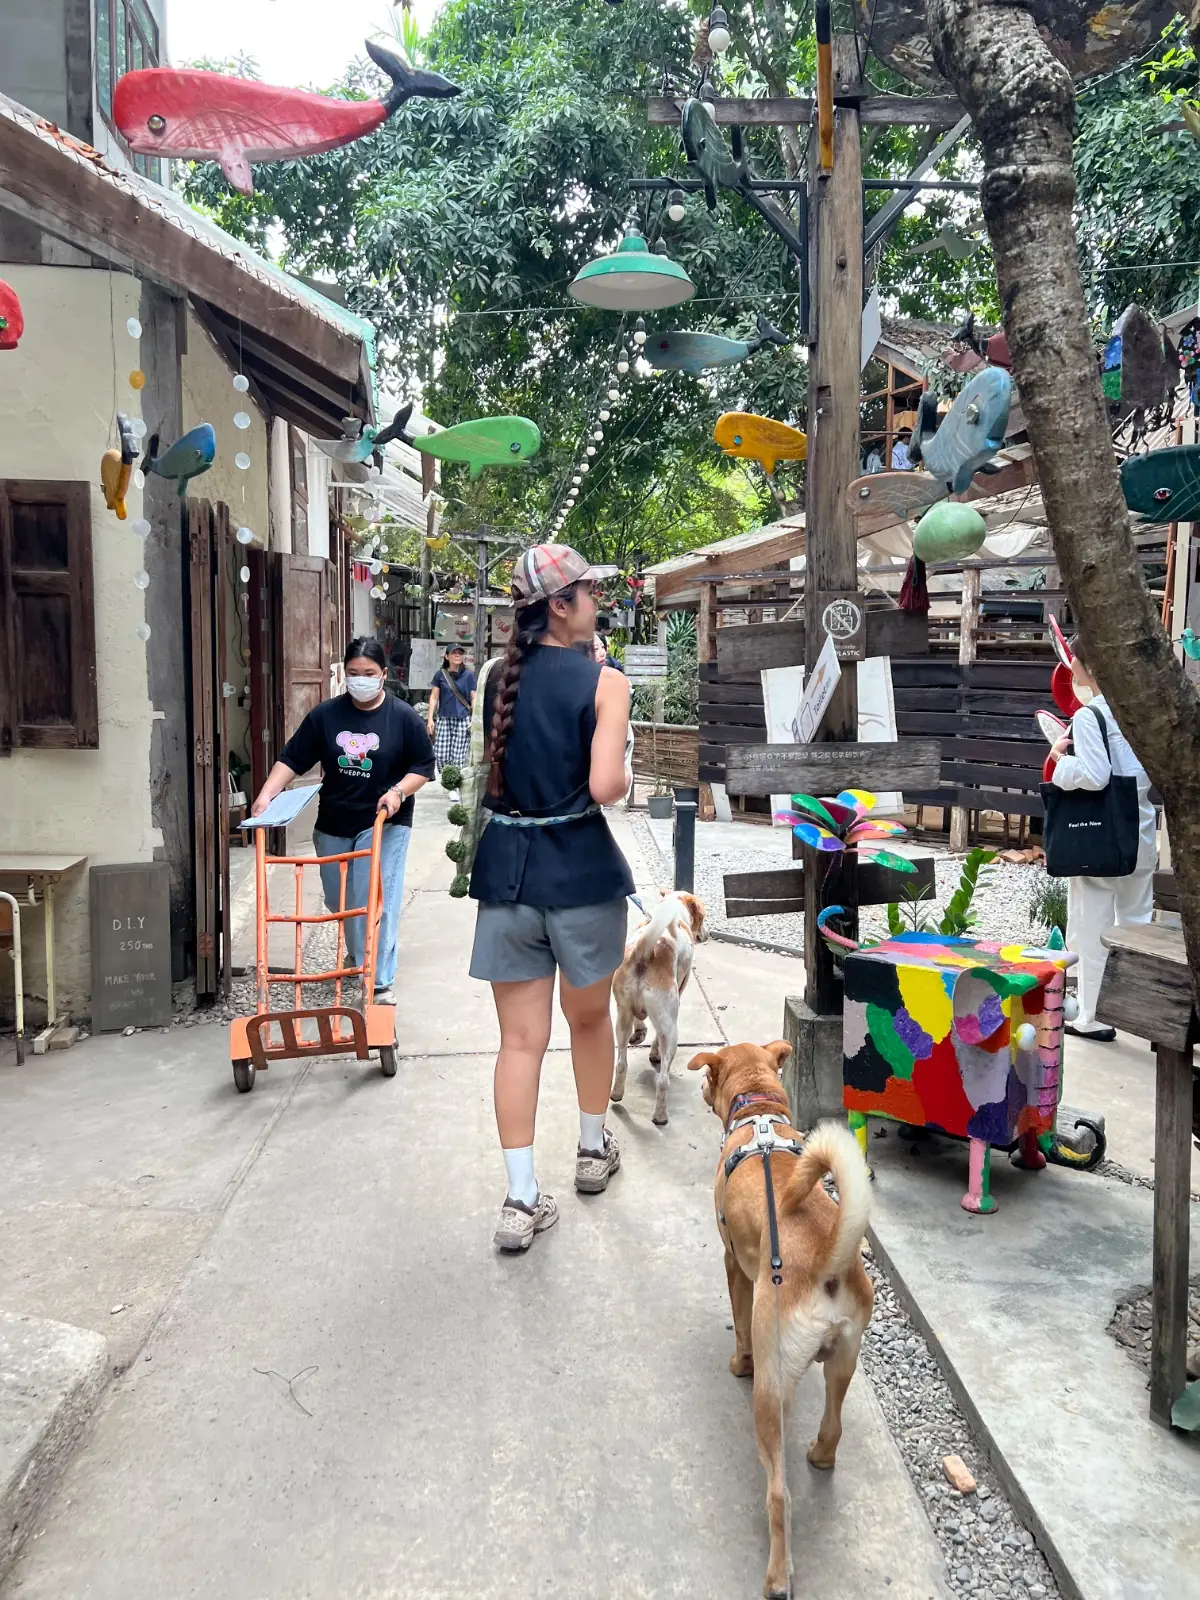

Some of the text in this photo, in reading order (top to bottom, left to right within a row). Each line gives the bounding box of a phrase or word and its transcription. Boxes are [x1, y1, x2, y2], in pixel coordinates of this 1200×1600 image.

[120, 940, 142, 951] 250
[104, 972, 157, 988] MAKE YOUR
